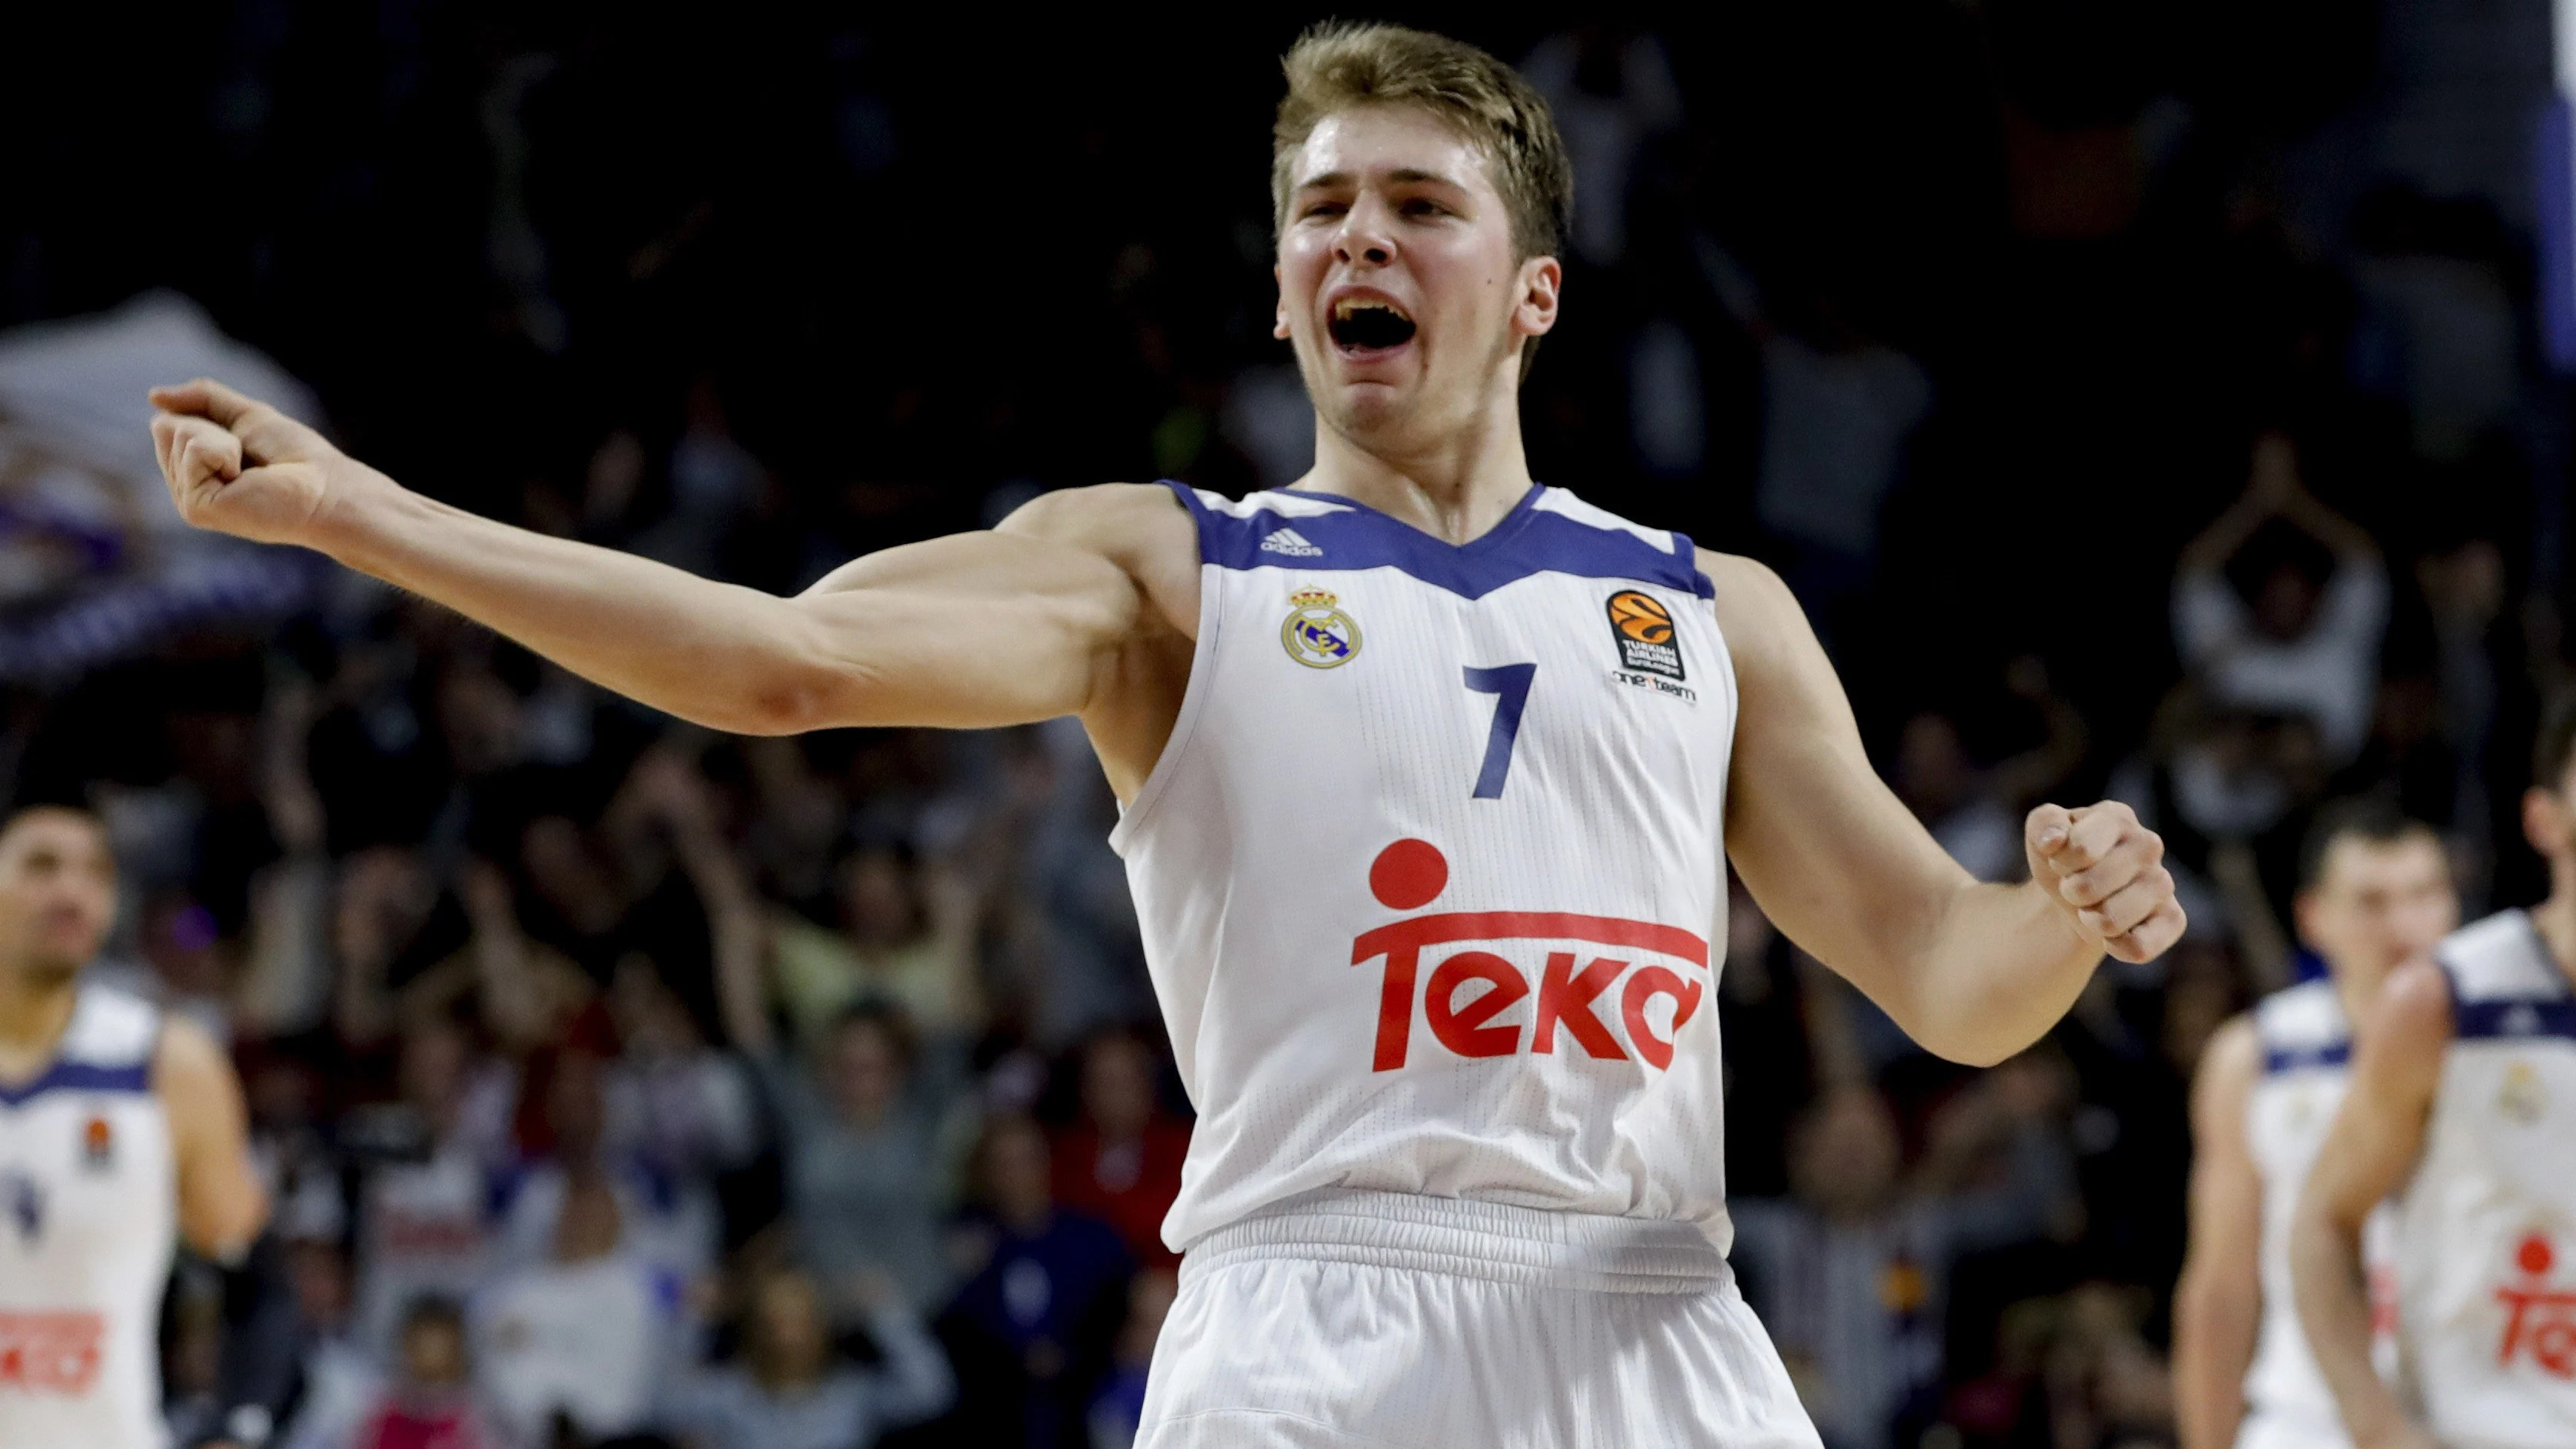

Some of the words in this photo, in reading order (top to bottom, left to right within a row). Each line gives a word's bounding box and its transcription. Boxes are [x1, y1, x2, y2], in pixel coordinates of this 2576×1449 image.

[1260, 542, 1323, 556] adidas
[1622, 639, 1676, 655] TURKISH
[1462, 663, 1538, 800] 7
